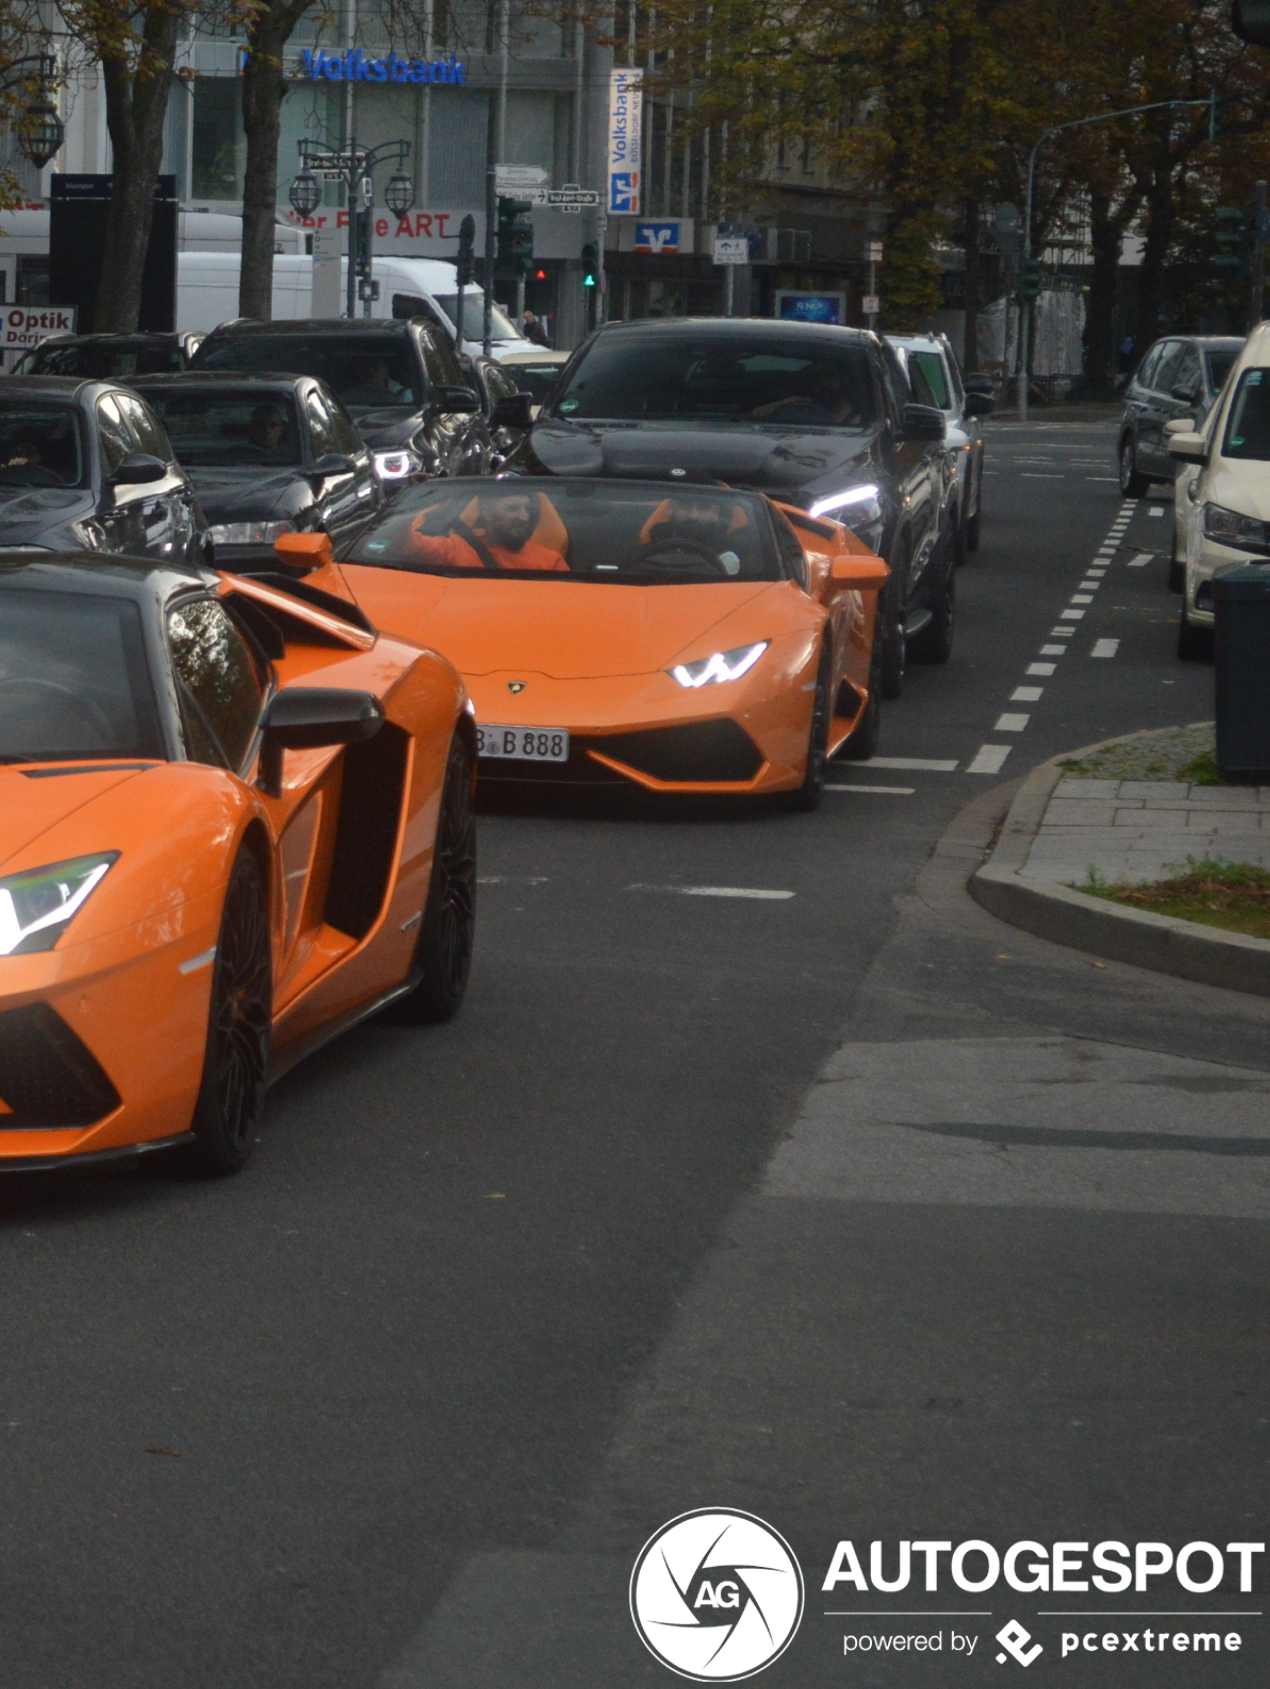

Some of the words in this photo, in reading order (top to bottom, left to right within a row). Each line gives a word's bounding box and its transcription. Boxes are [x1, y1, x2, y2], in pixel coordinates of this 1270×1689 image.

[303, 49, 467, 85] Volksbank
[612, 73, 628, 163] Volksbank
[630, 113, 641, 163] DÜSSELDORF
[394, 213, 450, 238] ART
[8, 310, 69, 332] Optik
[522, 733, 563, 757] 888
